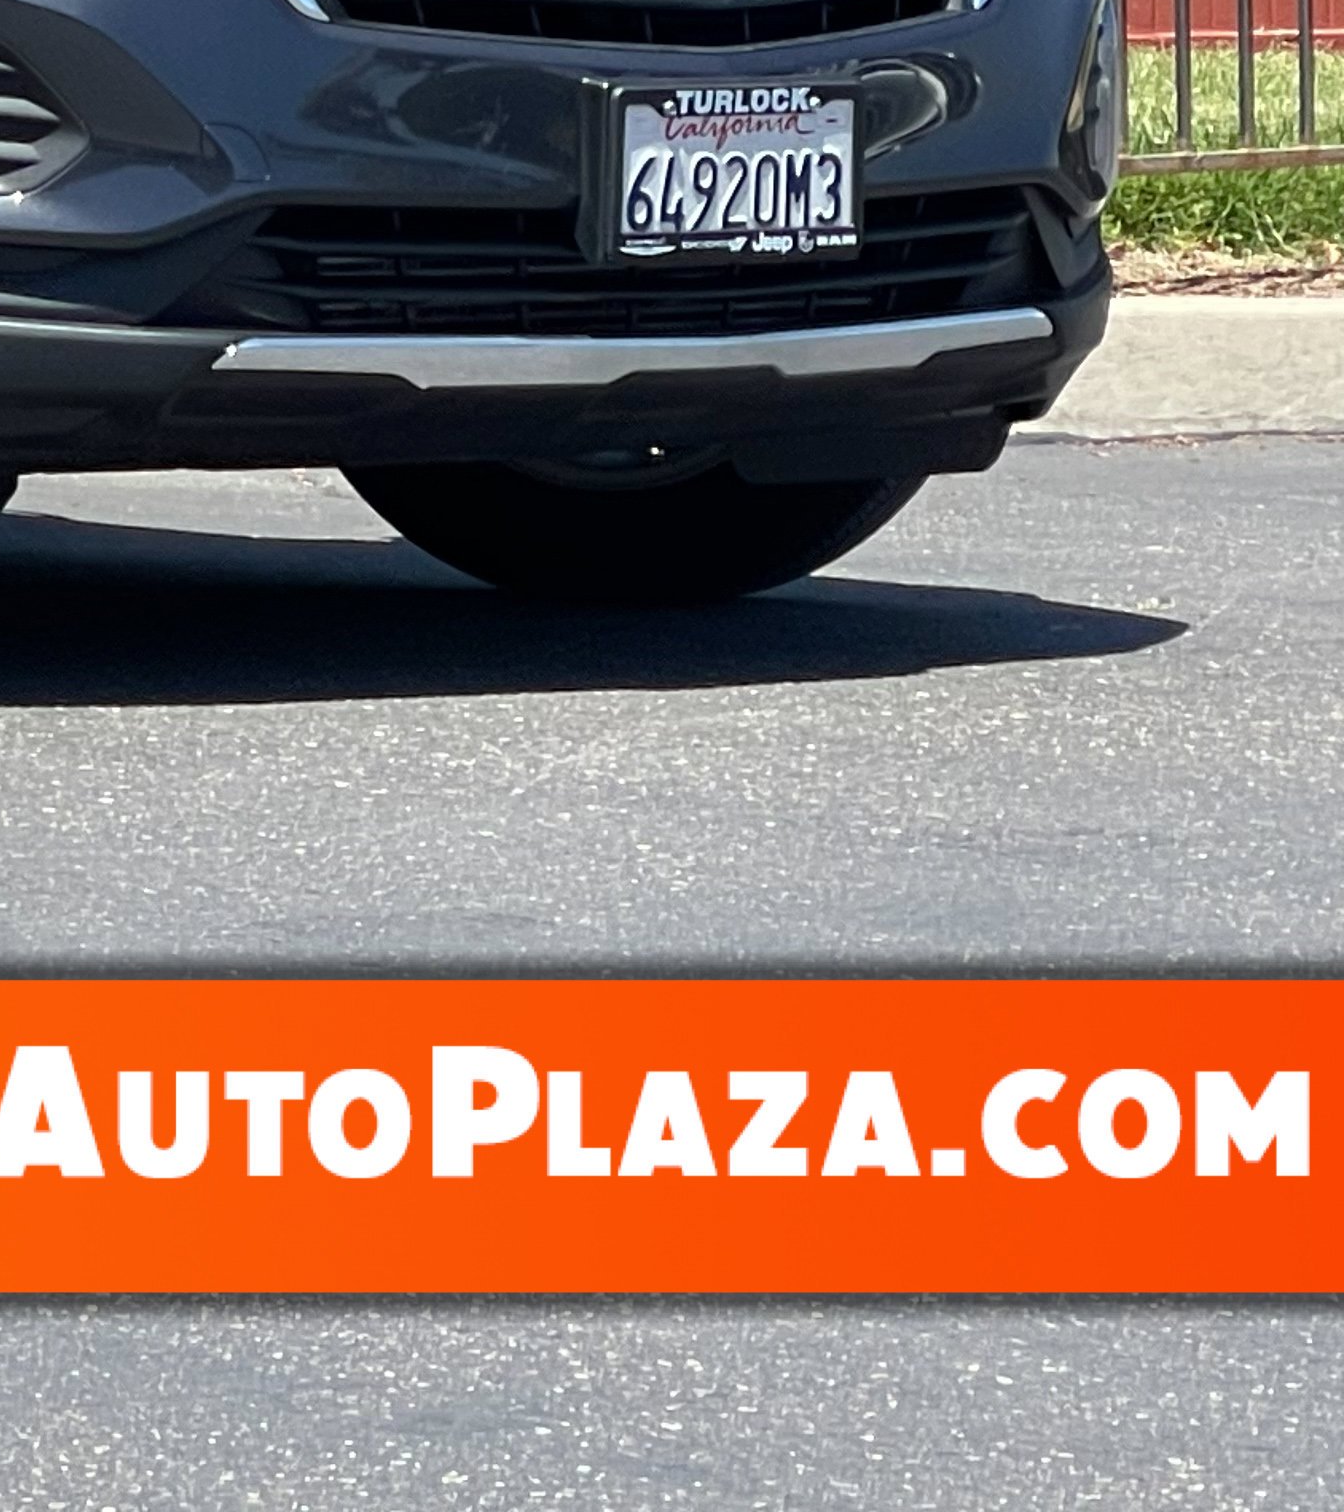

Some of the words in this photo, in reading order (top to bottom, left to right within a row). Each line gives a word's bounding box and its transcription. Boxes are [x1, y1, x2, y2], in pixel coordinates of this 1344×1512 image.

[675, 87, 812, 115] TURLOCK
[662, 112, 815, 150] California
[625, 152, 843, 232] 64920M3
